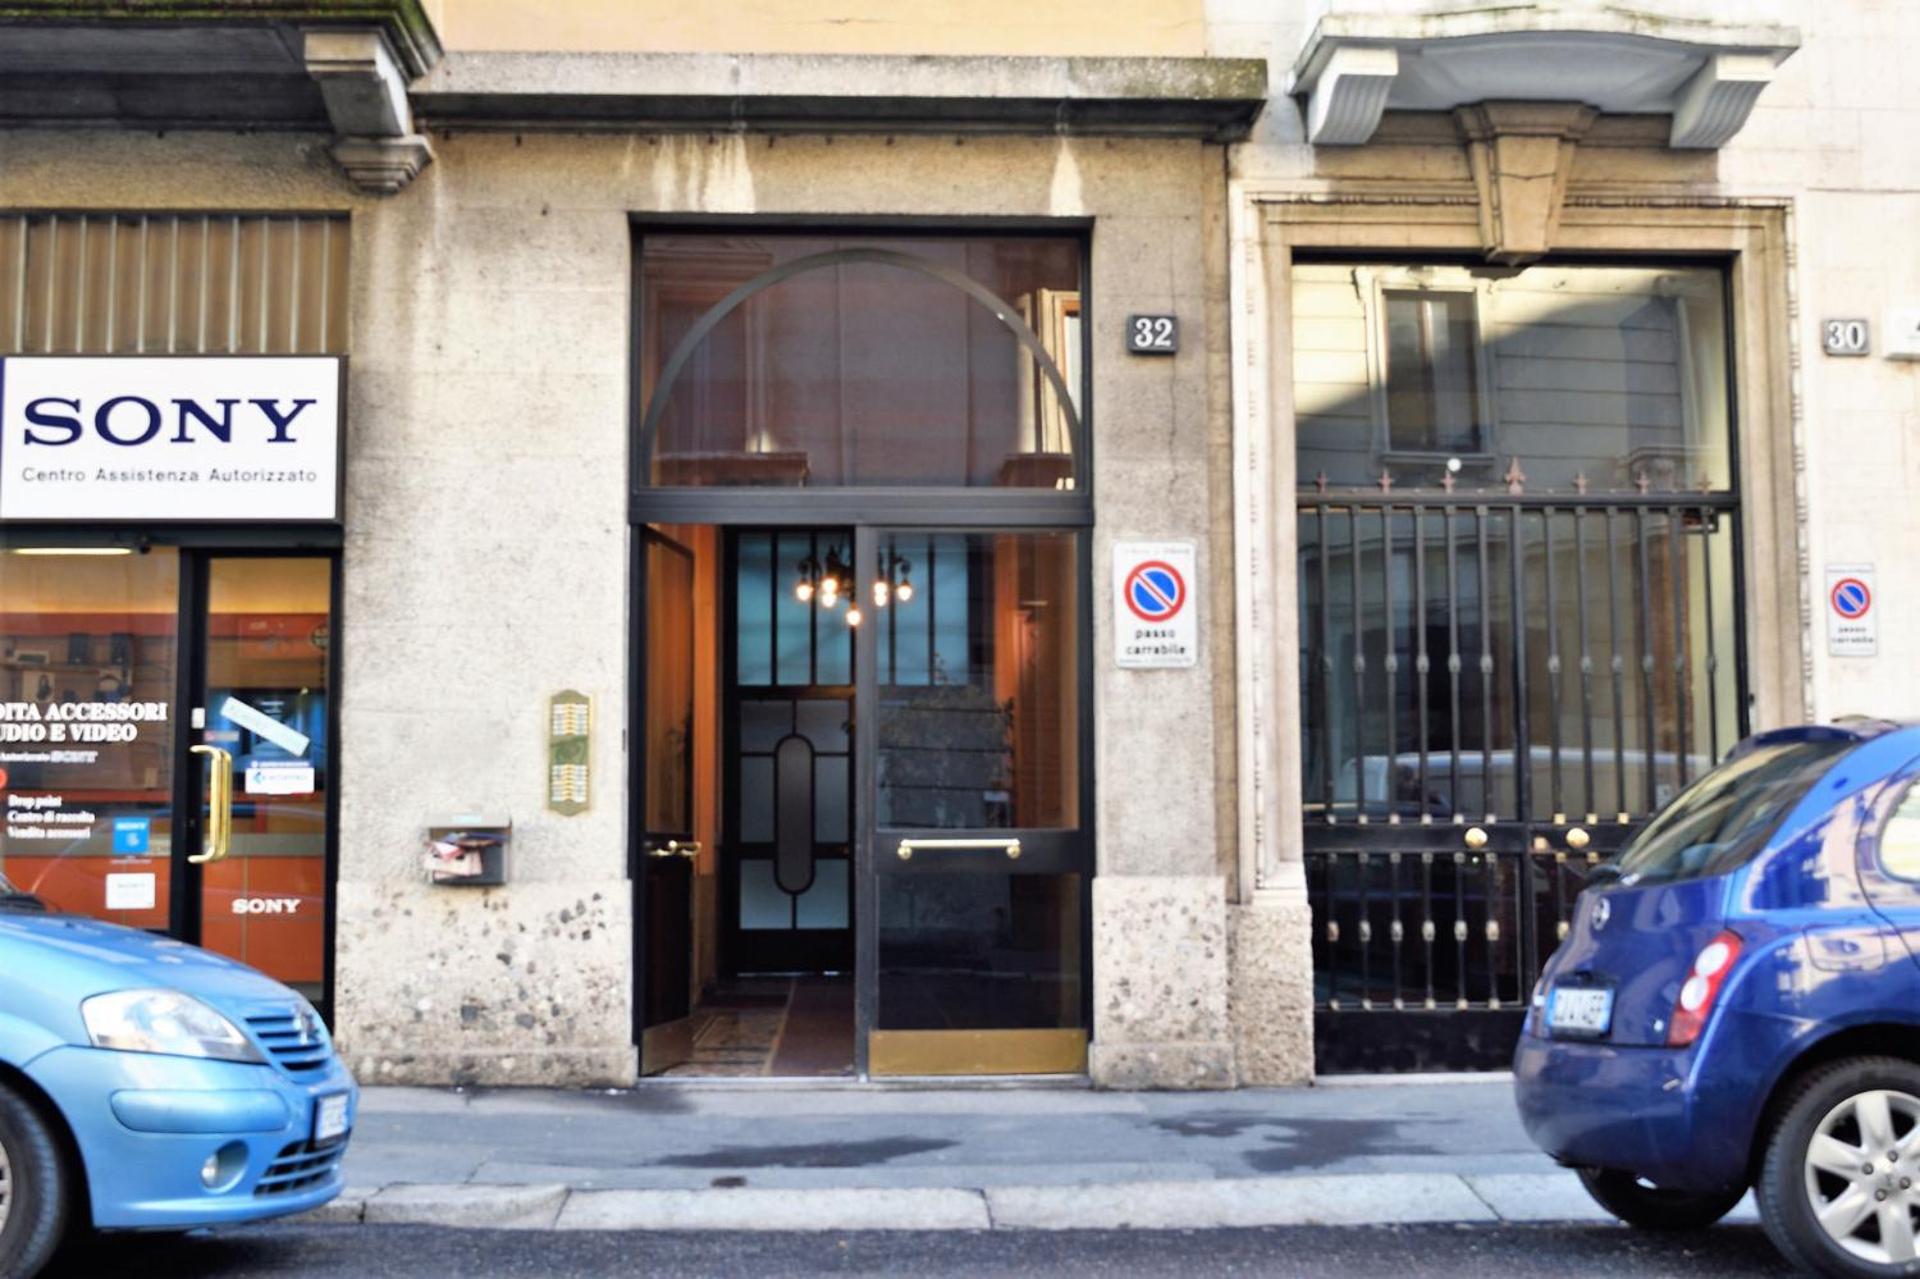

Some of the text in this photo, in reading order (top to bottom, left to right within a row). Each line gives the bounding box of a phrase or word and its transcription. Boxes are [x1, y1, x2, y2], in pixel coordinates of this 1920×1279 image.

[1135, 317, 1173, 347] 32
[1828, 321, 1865, 349] 30
[23, 395, 317, 447] SONY
[22, 467, 318, 482] Centro Assistenza Autorizzato
[1135, 628, 1176, 640] passo
[1126, 643, 1186, 655] carrabile
[45, 702, 168, 721] ACCESSORI
[50, 723, 66, 742] E
[69, 723, 138, 742] VIDEO
[232, 899, 300, 914] SONY
